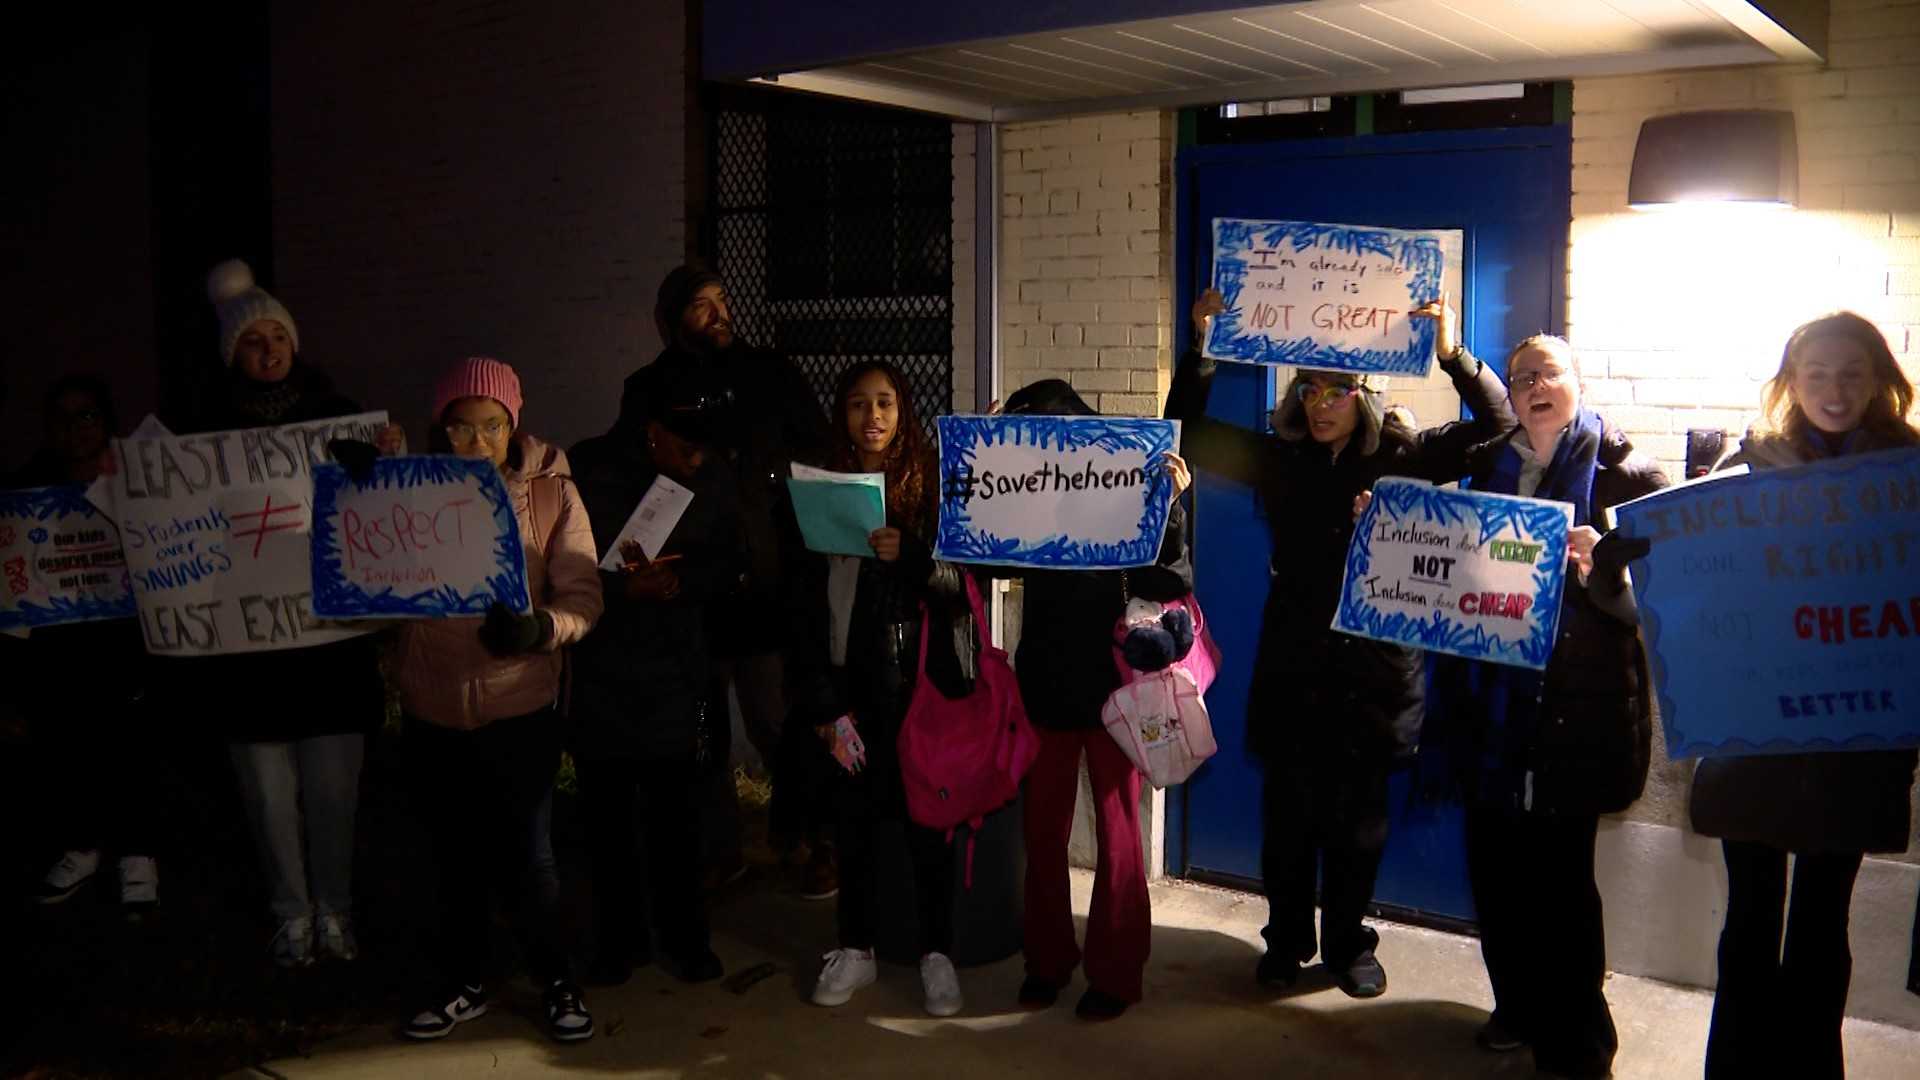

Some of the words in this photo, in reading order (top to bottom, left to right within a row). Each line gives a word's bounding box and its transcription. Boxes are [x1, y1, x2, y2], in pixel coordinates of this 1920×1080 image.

[1249, 250, 1296, 271] I'm
[1309, 255, 1367, 277] already
[1256, 278, 1285, 291] and
[1311, 278, 1323, 292] it
[1343, 278, 1359, 293] is
[1250, 303, 1294, 330] NOT
[1311, 303, 1398, 336] GREAT
[119, 432, 232, 498] LEAST
[1376, 522, 1450, 547] Inclusion
[155, 545, 194, 561] over
[1413, 555, 1456, 579] NOT
[1764, 534, 1917, 577] RIGHT
[134, 547, 232, 592] SAVINGS
[1365, 576, 1427, 606] Inclusion
[1459, 592, 1533, 620] CHEAP
[142, 603, 223, 650] LEAST
[1779, 688, 1896, 718] BETTER
